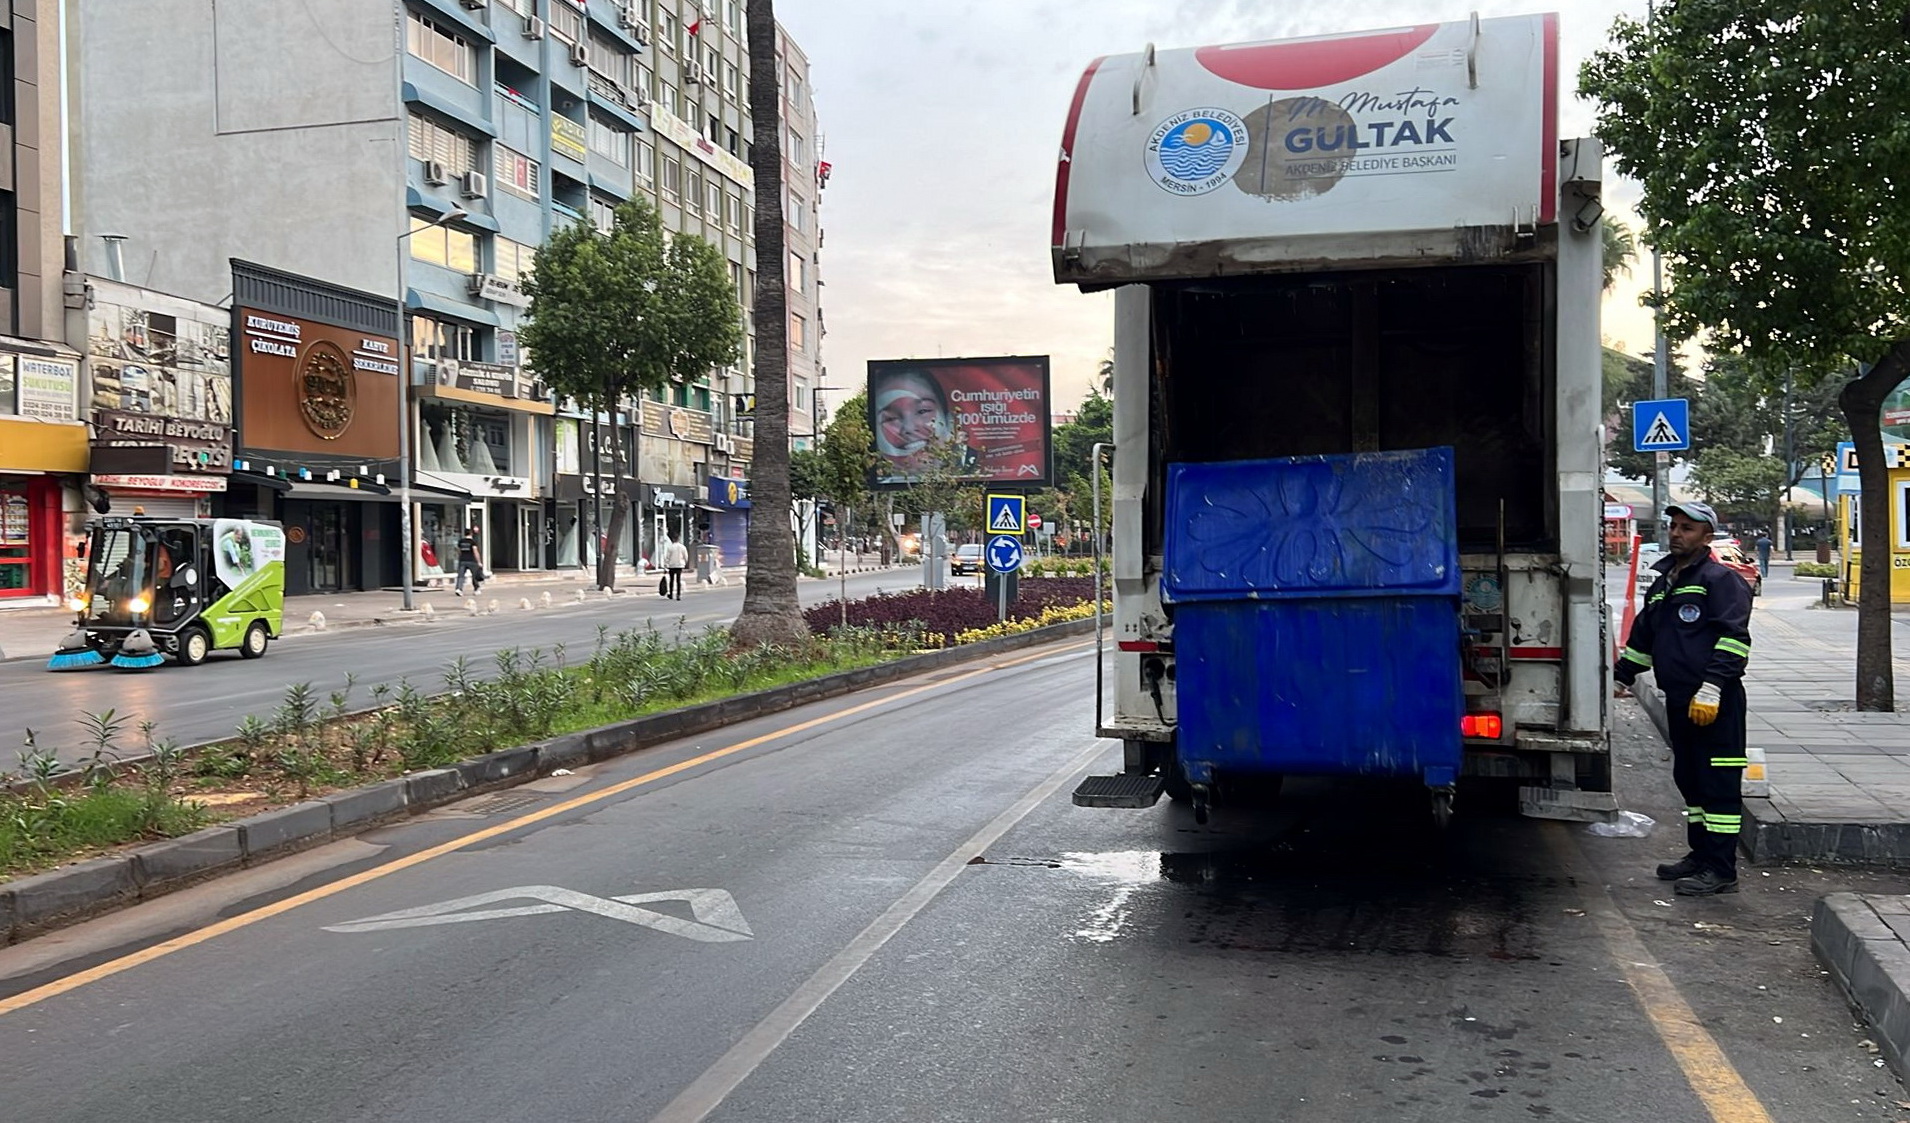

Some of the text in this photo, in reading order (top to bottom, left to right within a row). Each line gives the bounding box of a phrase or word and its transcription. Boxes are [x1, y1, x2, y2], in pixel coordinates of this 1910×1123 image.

[1337, 86, 1460, 118] Mustafa
[1148, 110, 1247, 152] AKDENİZ BELEDİYESİ
[1340, 157, 1399, 172] BELEDİYE
[1402, 154, 1457, 170] BAŞKANI
[1161, 176, 1197, 193] MERSİN
[1206, 171, 1228, 189] 1994
[251, 338, 297, 358] ÇİKOLATA
[23, 361, 72, 377] WATERBOX
[951, 388, 1040, 403] Cumhuriyetin
[981, 401, 1007, 415] ışığı
[957, 411, 1037, 426] 100'ümüzde
[115, 417, 225, 441] TARİHİ BEYOĞLU
[111, 440, 230, 471] REÇİSİ
